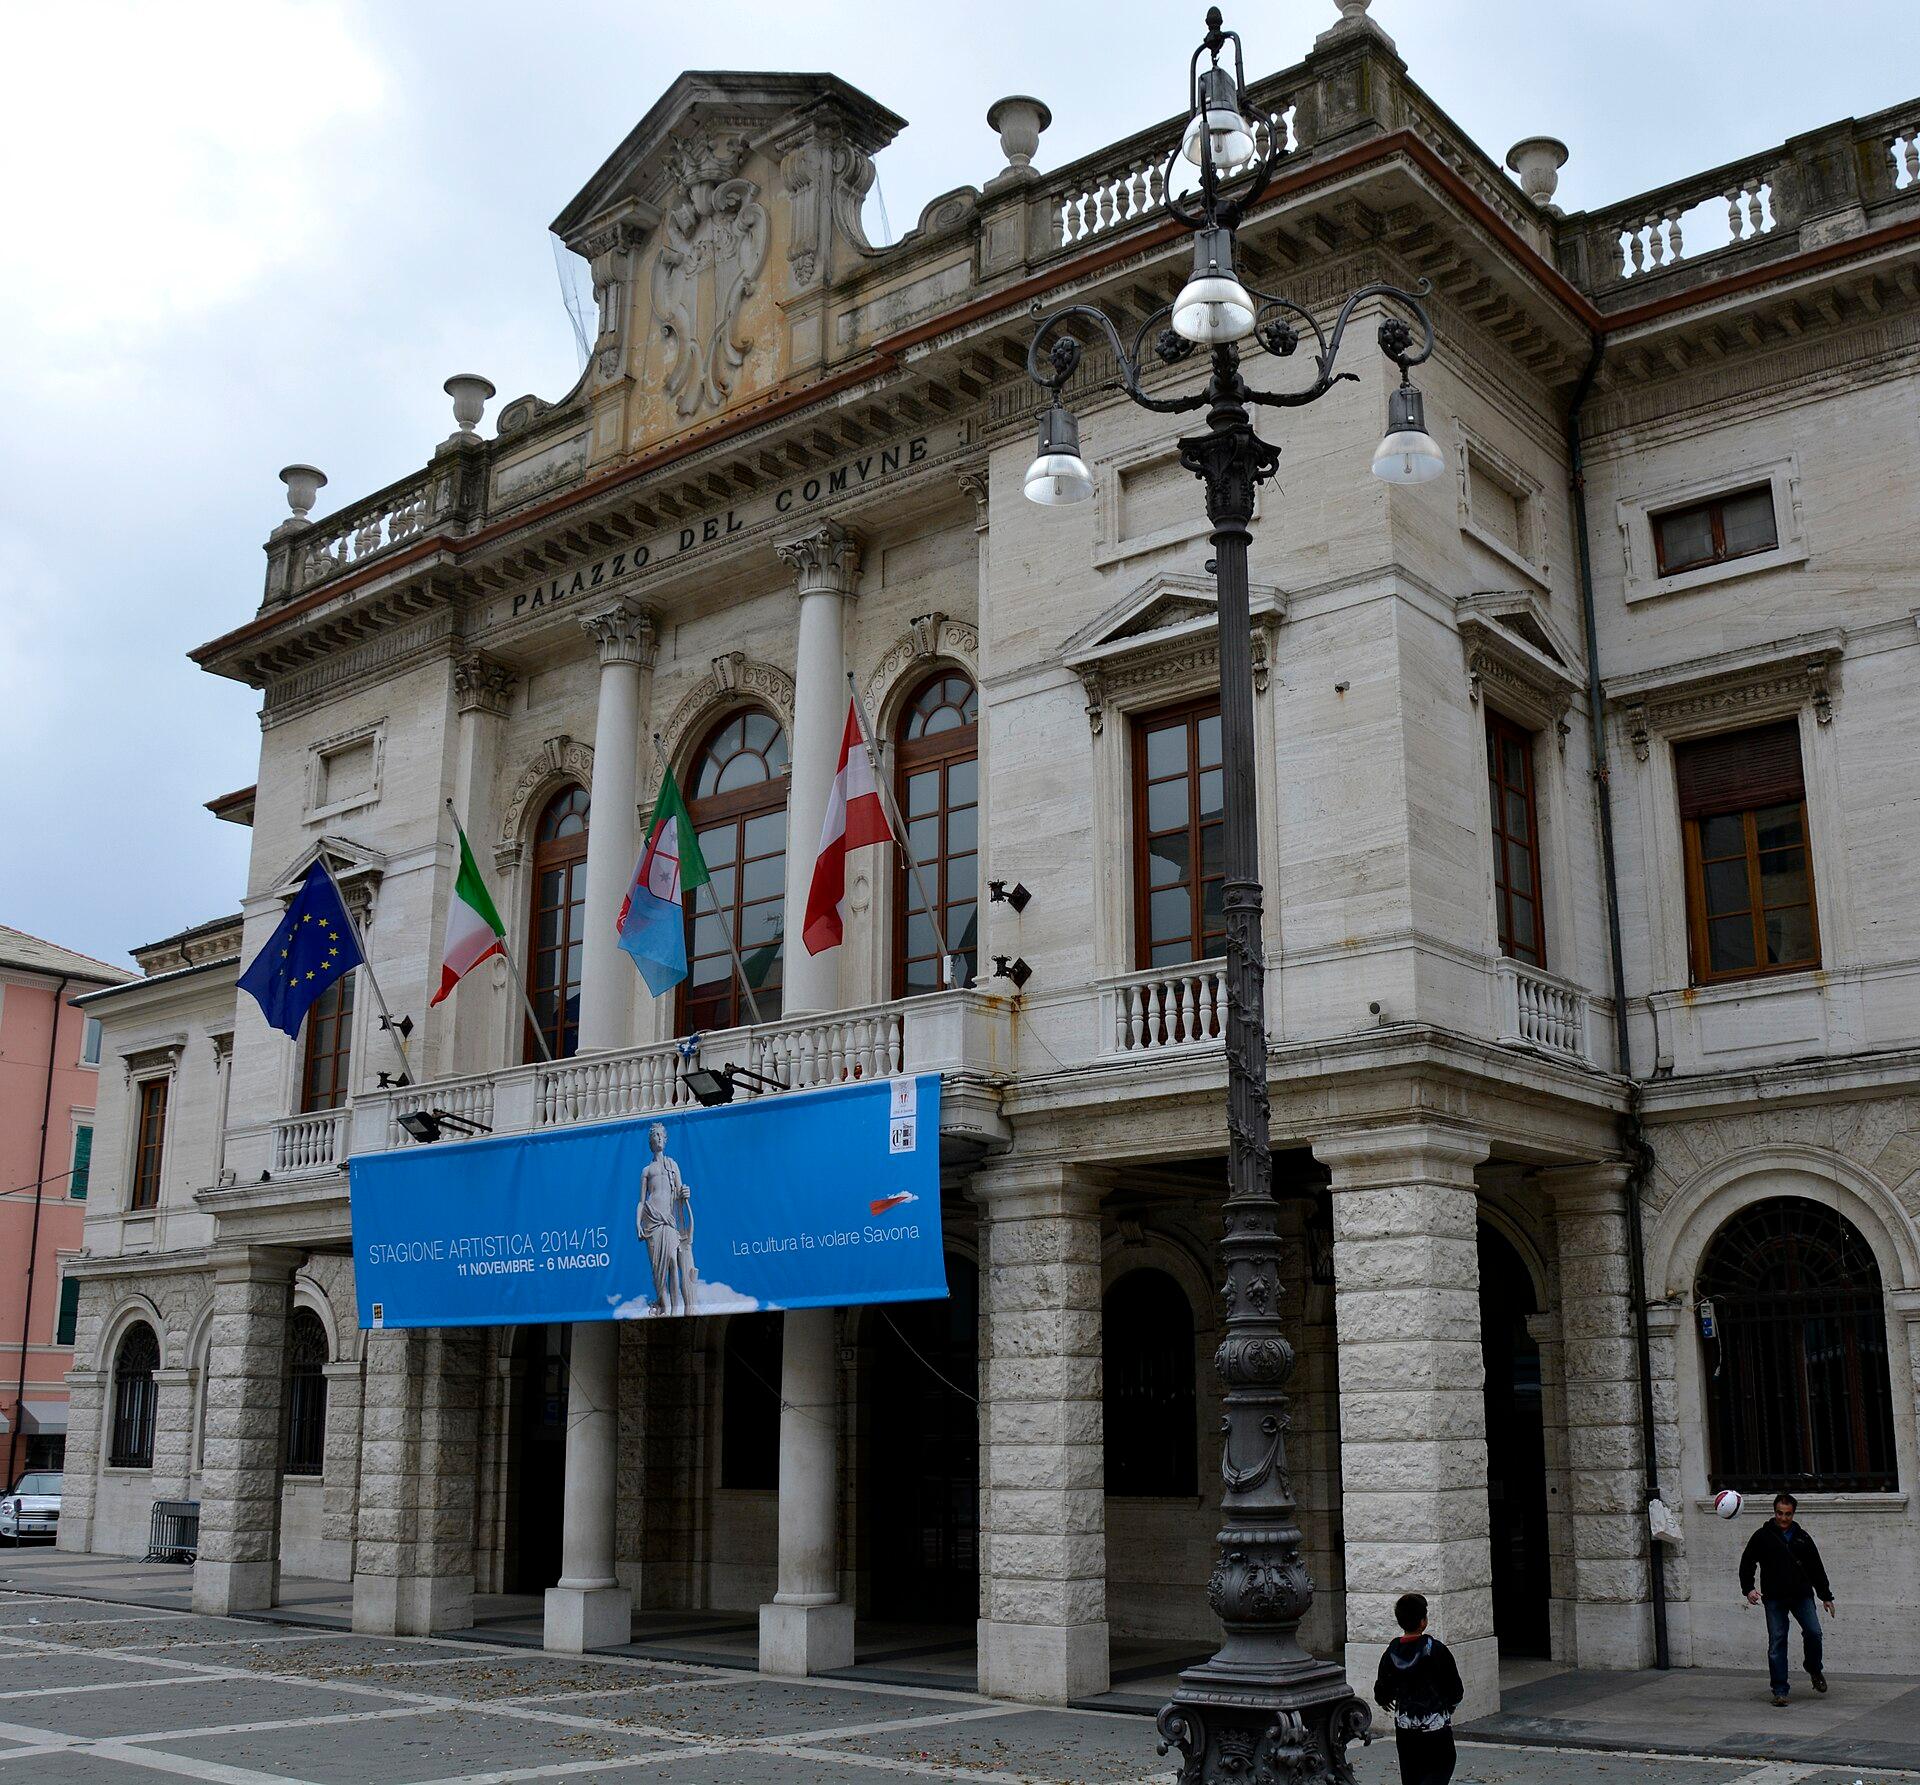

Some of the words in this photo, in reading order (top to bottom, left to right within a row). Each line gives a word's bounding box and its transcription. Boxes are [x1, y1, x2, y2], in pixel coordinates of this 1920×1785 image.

[512, 546, 650, 617] PALAZZO
[679, 511, 743, 551] DEL
[775, 437, 928, 512] COMVNE
[369, 1240, 444, 1264] STAGIONE
[449, 1233, 534, 1258] ARTISTICA
[540, 1227, 608, 1253] 2014/15
[732, 1240, 749, 1256] La
[752, 1236, 798, 1253] cultura
[800, 1232, 814, 1249] fa
[818, 1230, 860, 1247] volare
[863, 1225, 920, 1243] Savona
[457, 1263, 468, 1276] 11
[470, 1260, 535, 1275] NOVEMBRE
[547, 1257, 555, 1271] 6
[557, 1252, 610, 1270] MAGGIO
